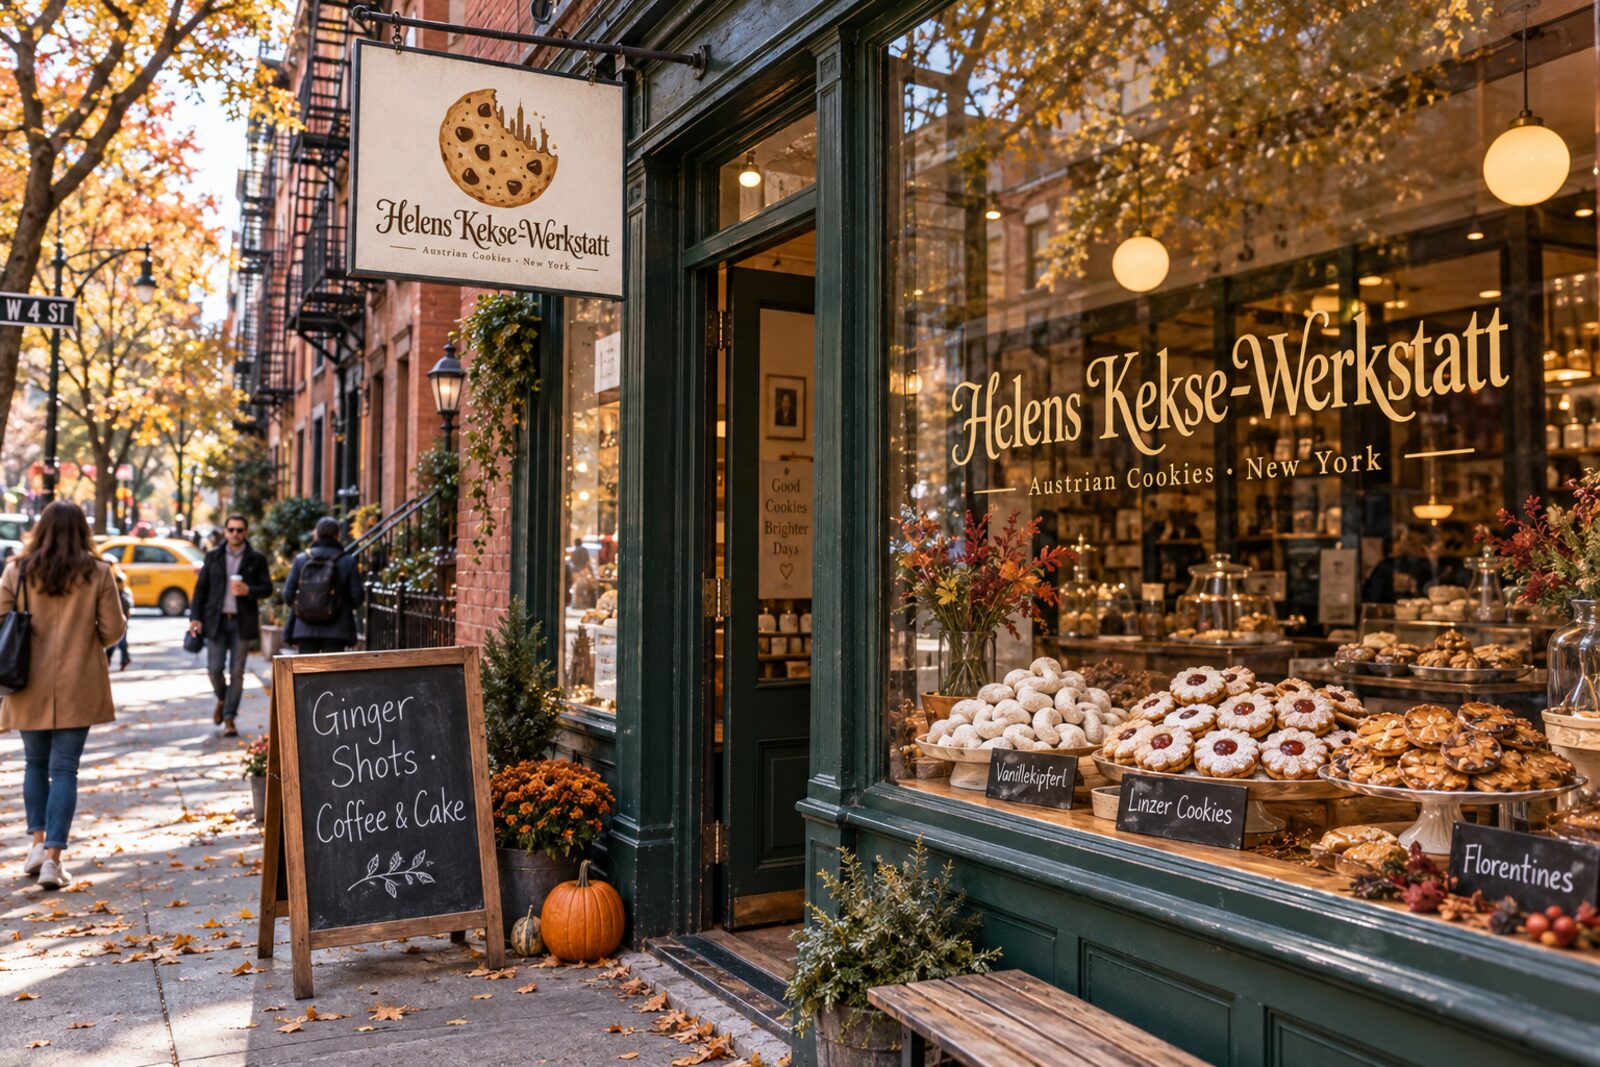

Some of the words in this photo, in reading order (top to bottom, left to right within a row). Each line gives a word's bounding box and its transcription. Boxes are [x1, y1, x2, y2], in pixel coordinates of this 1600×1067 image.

[376, 198, 452, 236] Helens
[453, 209, 610, 260] Kekse-Werkstatt
[422, 246, 468, 259] Austrian
[472, 251, 512, 264] Cookies
[523, 257, 544, 268] New
[548, 260, 571, 271] York
[7, 299, 22, 321] W
[27, 302, 41, 322] 4
[48, 303, 68, 323] ST
[952, 371, 1082, 467] Helens
[1086, 307, 1510, 457] Kekse-Werkstatt
[771, 478, 801, 493] Good
[1028, 471, 1117, 497] Austrian
[1126, 463, 1215, 489] Cookies
[1246, 457, 1300, 481] New
[1314, 445, 1382, 475] York
[765, 499, 807, 514] Cookies
[764, 520, 809, 538] Brighter
[773, 541, 799, 558] Days
[312, 691, 414, 745] Ginger
[332, 740, 418, 788] Shots
[996, 762, 1068, 793] Vanillekipferl
[316, 800, 389, 843] Coffee
[395, 801, 408, 829] &
[414, 786, 467, 828] Cake
[1128, 788, 1173, 816] Linzer
[1177, 795, 1233, 825] Cookies
[1463, 844, 1574, 893] Florentines
